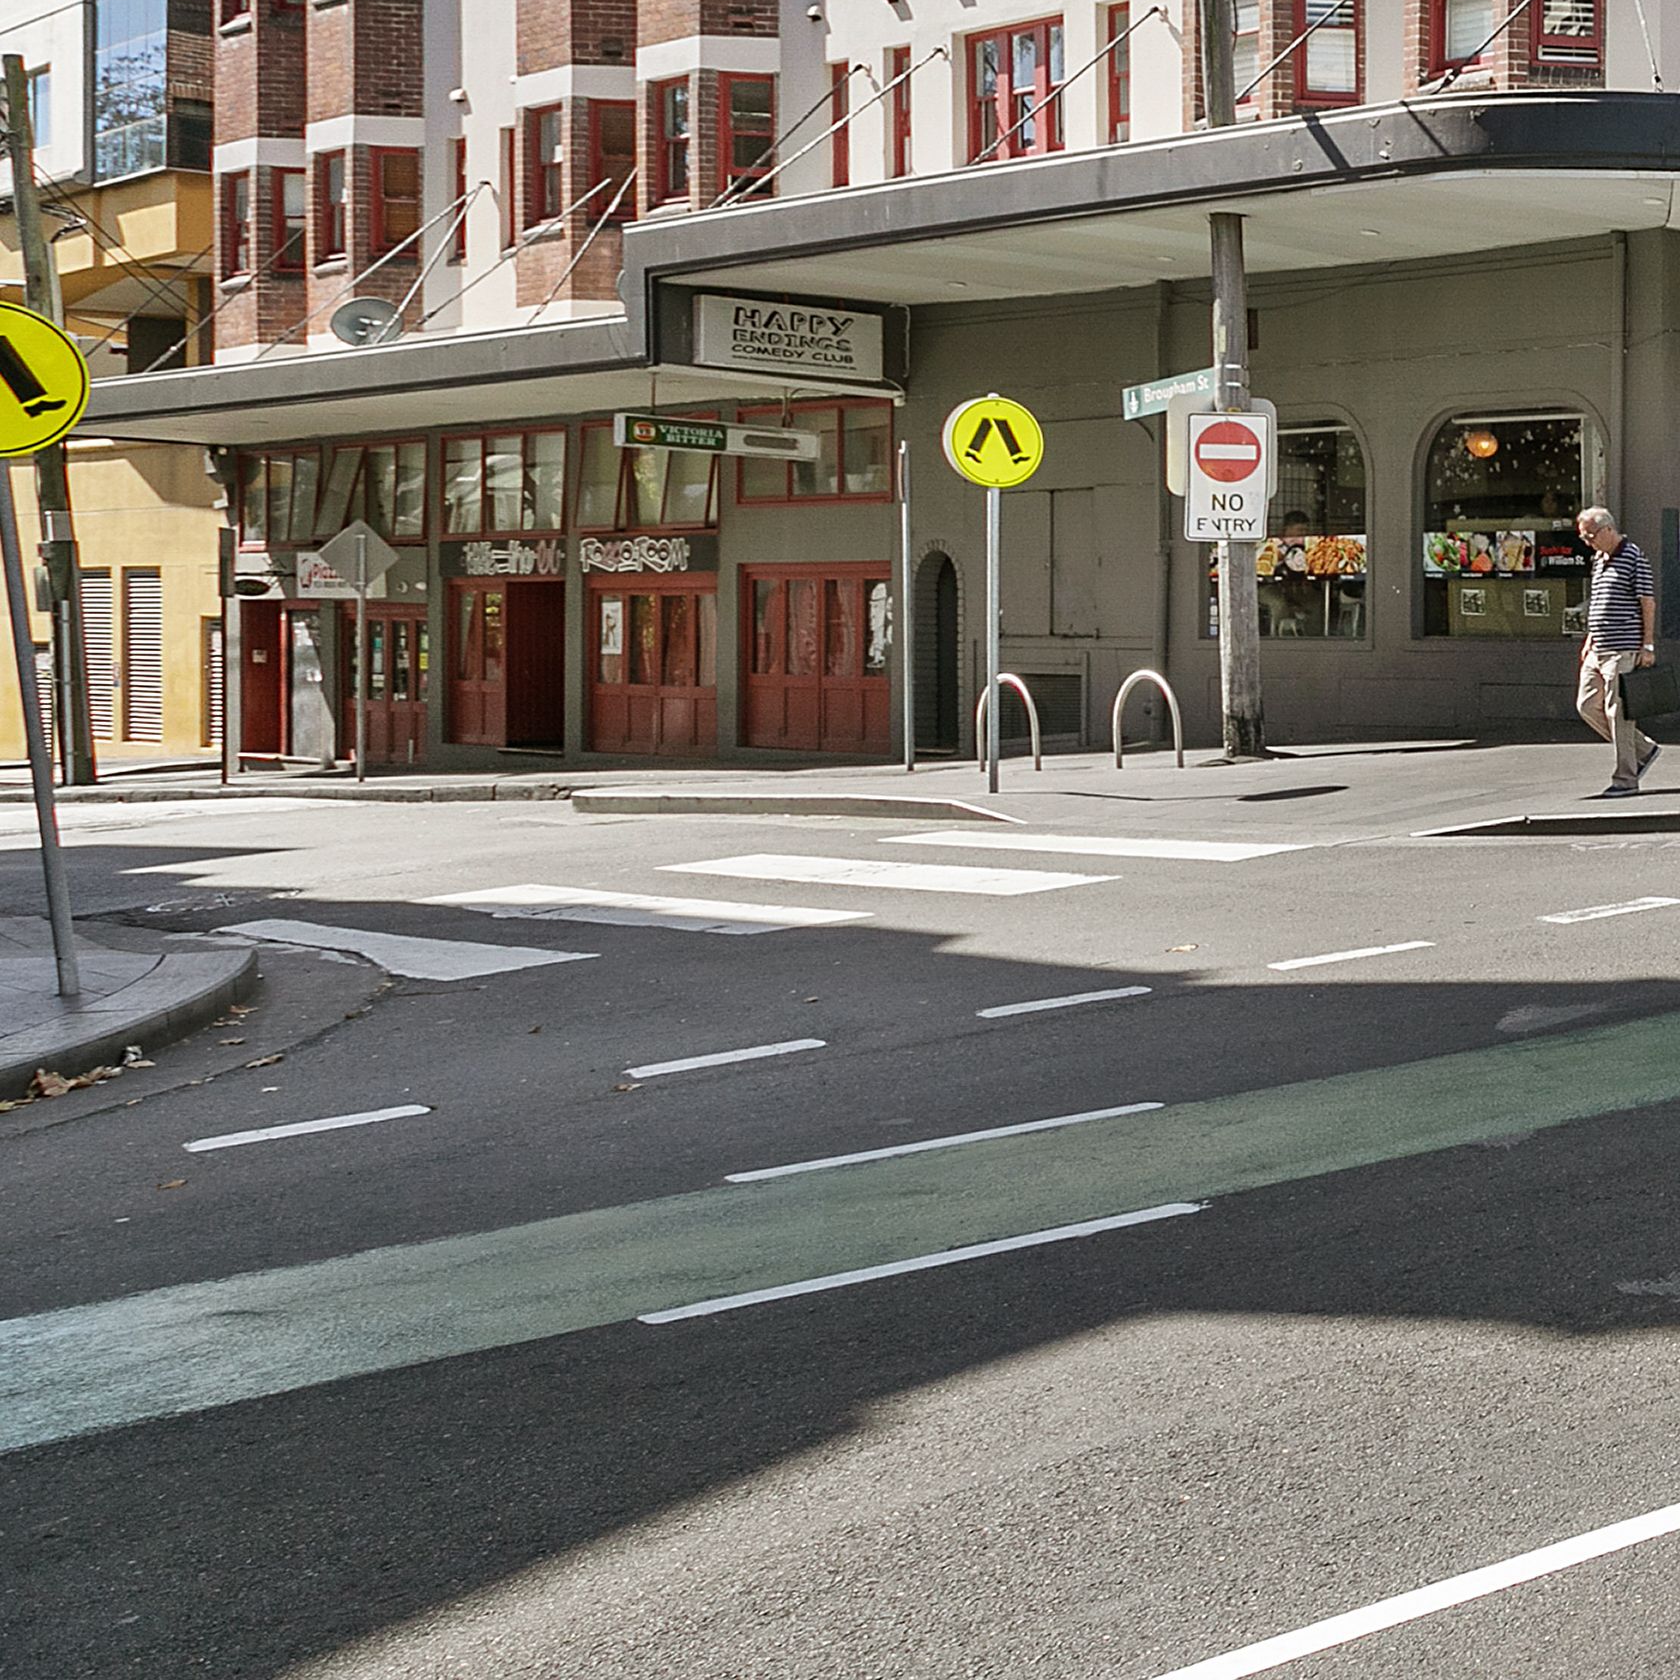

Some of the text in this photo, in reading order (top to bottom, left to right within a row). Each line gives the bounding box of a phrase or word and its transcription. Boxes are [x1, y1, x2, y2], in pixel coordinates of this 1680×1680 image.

[733, 306, 855, 337] HAPPY
[732, 328, 853, 352] ENDINGS
[731, 343, 854, 364] COMEDY CLUB
[1144, 374, 1209, 403] Brougham St
[658, 424, 724, 439] VICTORIA
[666, 432, 717, 446] BITTER
[1211, 493, 1244, 511] NO
[1197, 518, 1257, 532] ENTRY
